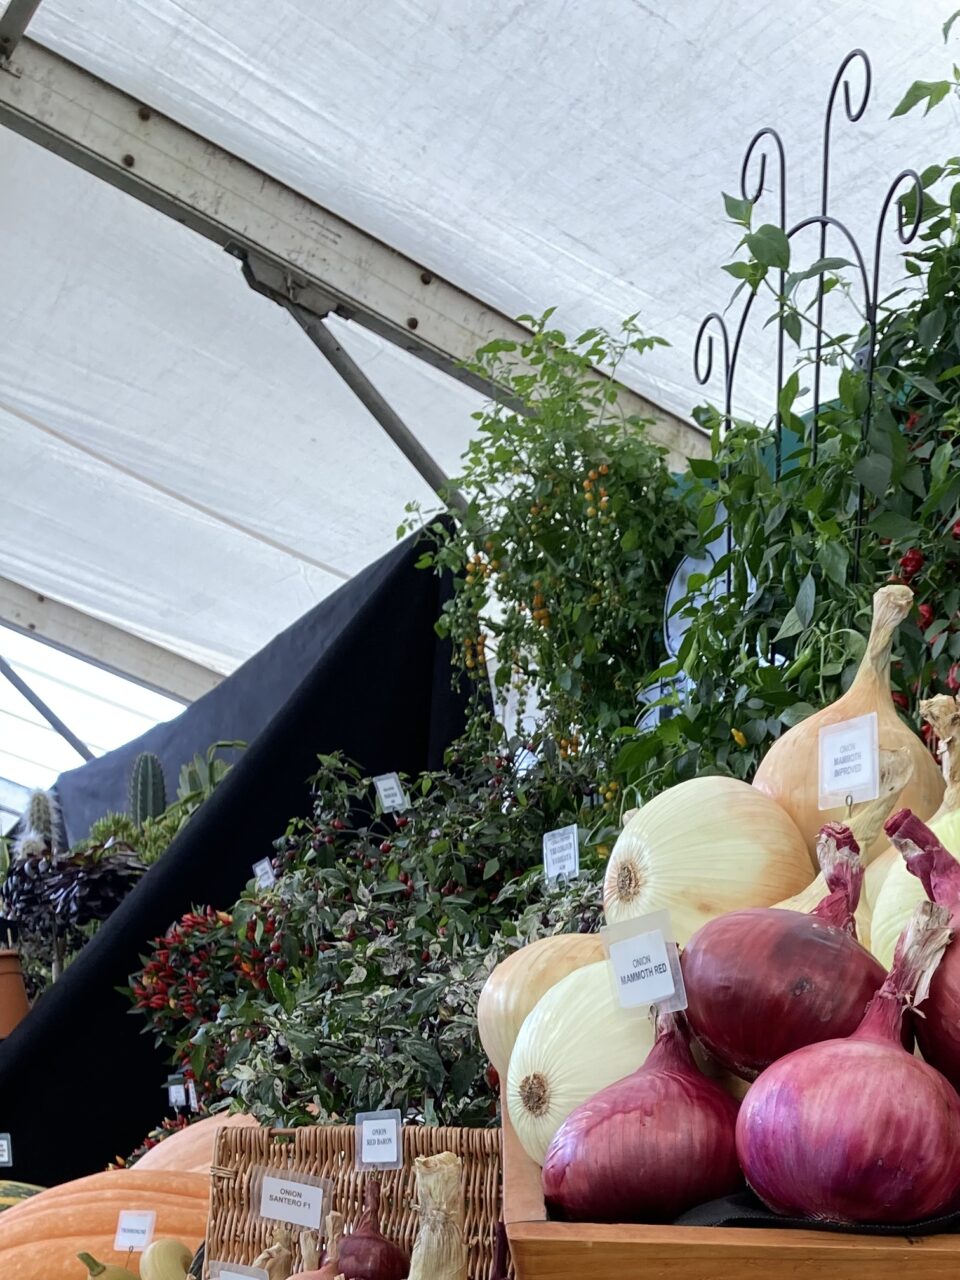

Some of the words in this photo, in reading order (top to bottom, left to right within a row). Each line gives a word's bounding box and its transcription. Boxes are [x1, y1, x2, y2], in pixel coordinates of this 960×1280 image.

[632, 955, 652, 968] ONION
[620, 967, 655, 985] MAMMOTH
[654, 963, 667, 975] RED
[280, 1188, 302, 1198] ONION
[269, 1194, 301, 1207] SANTERO
